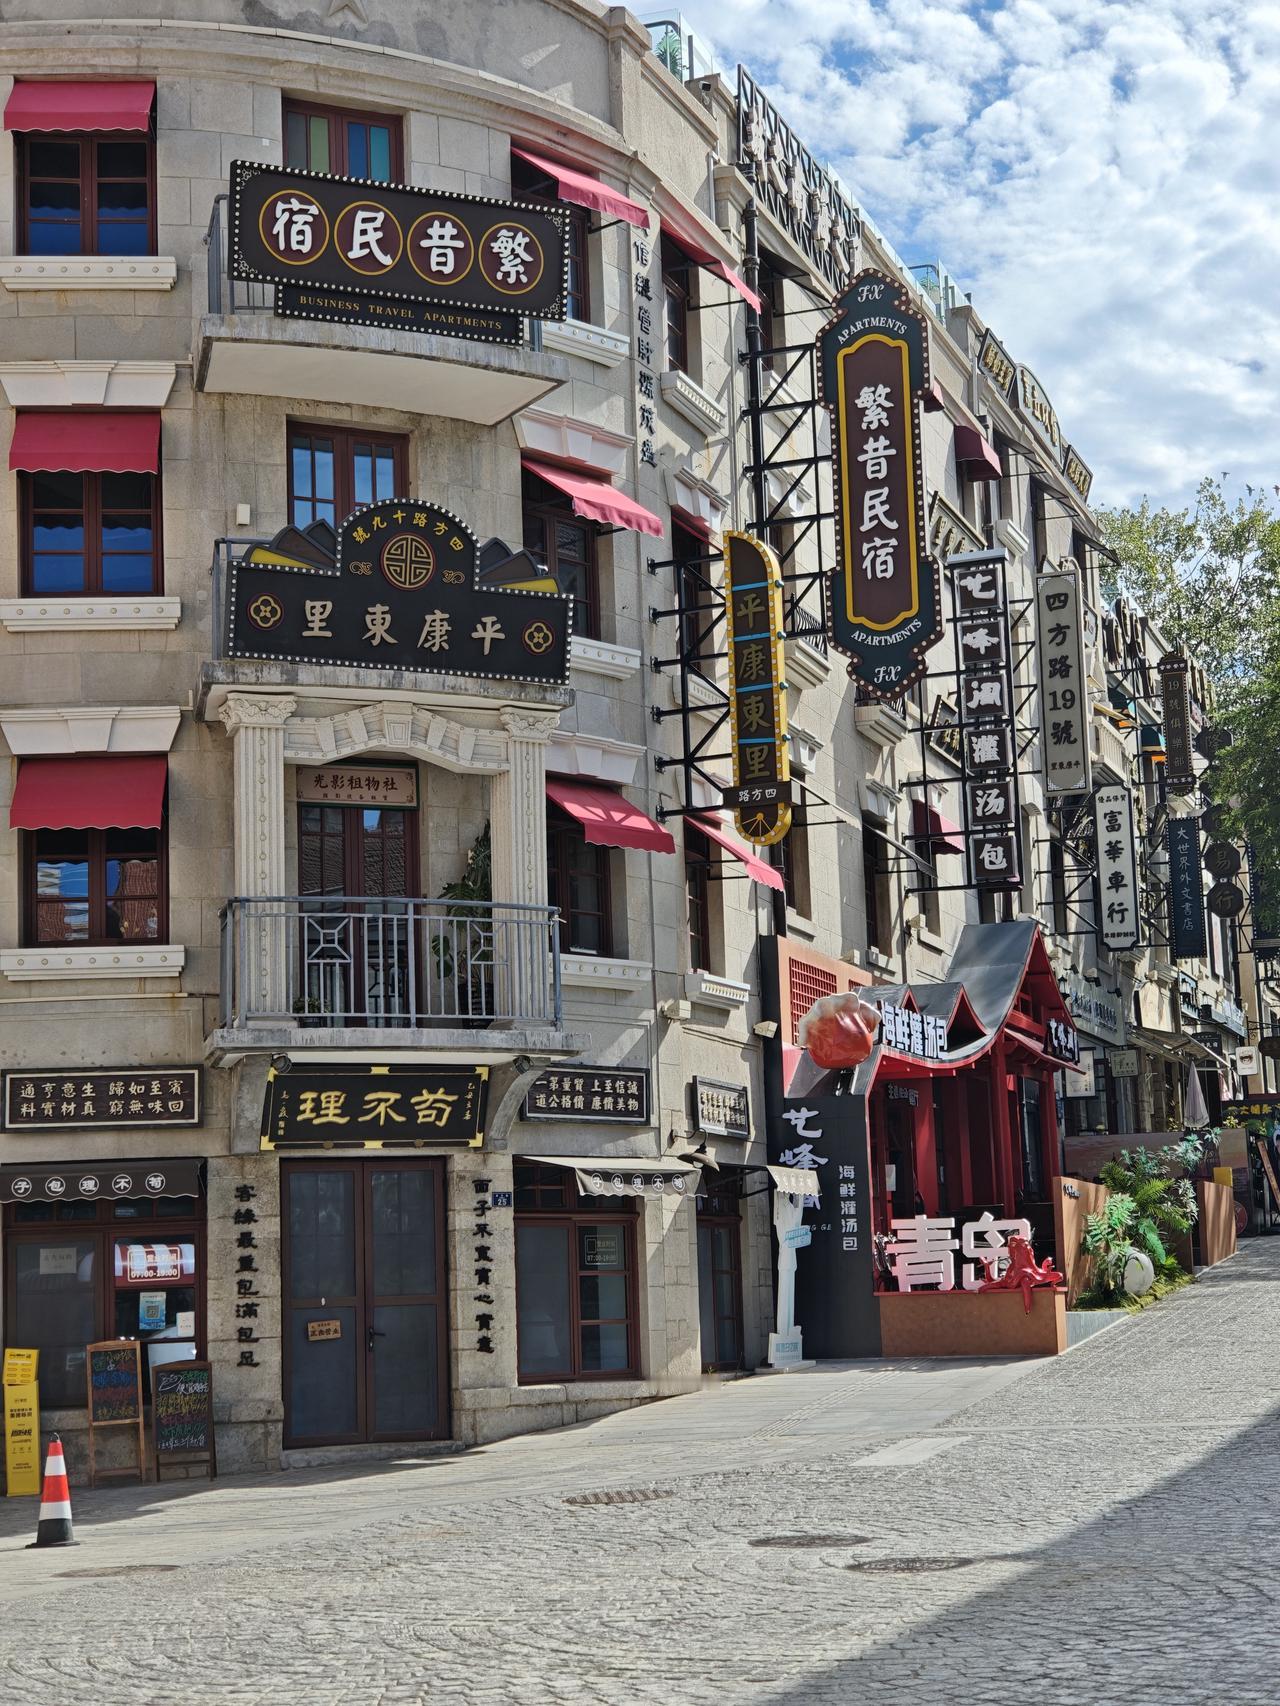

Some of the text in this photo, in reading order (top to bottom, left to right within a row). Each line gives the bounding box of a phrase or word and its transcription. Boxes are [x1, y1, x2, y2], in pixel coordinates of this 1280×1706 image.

[300, 296, 502, 330] BUSINESS TRAVEL APARTMENTS
[837, 317, 908, 345] APARTMENTS
[855, 383, 899, 580] 繁昔民宿
[851, 618, 922, 646] APARTMENTS
[736, 593, 772, 779] 平康東里
[1103, 810, 1128, 924] 富華車行
[1176, 827, 1193, 931] 大世界外文書店
[839, 1165, 858, 1251] 海鲜灌汤包
